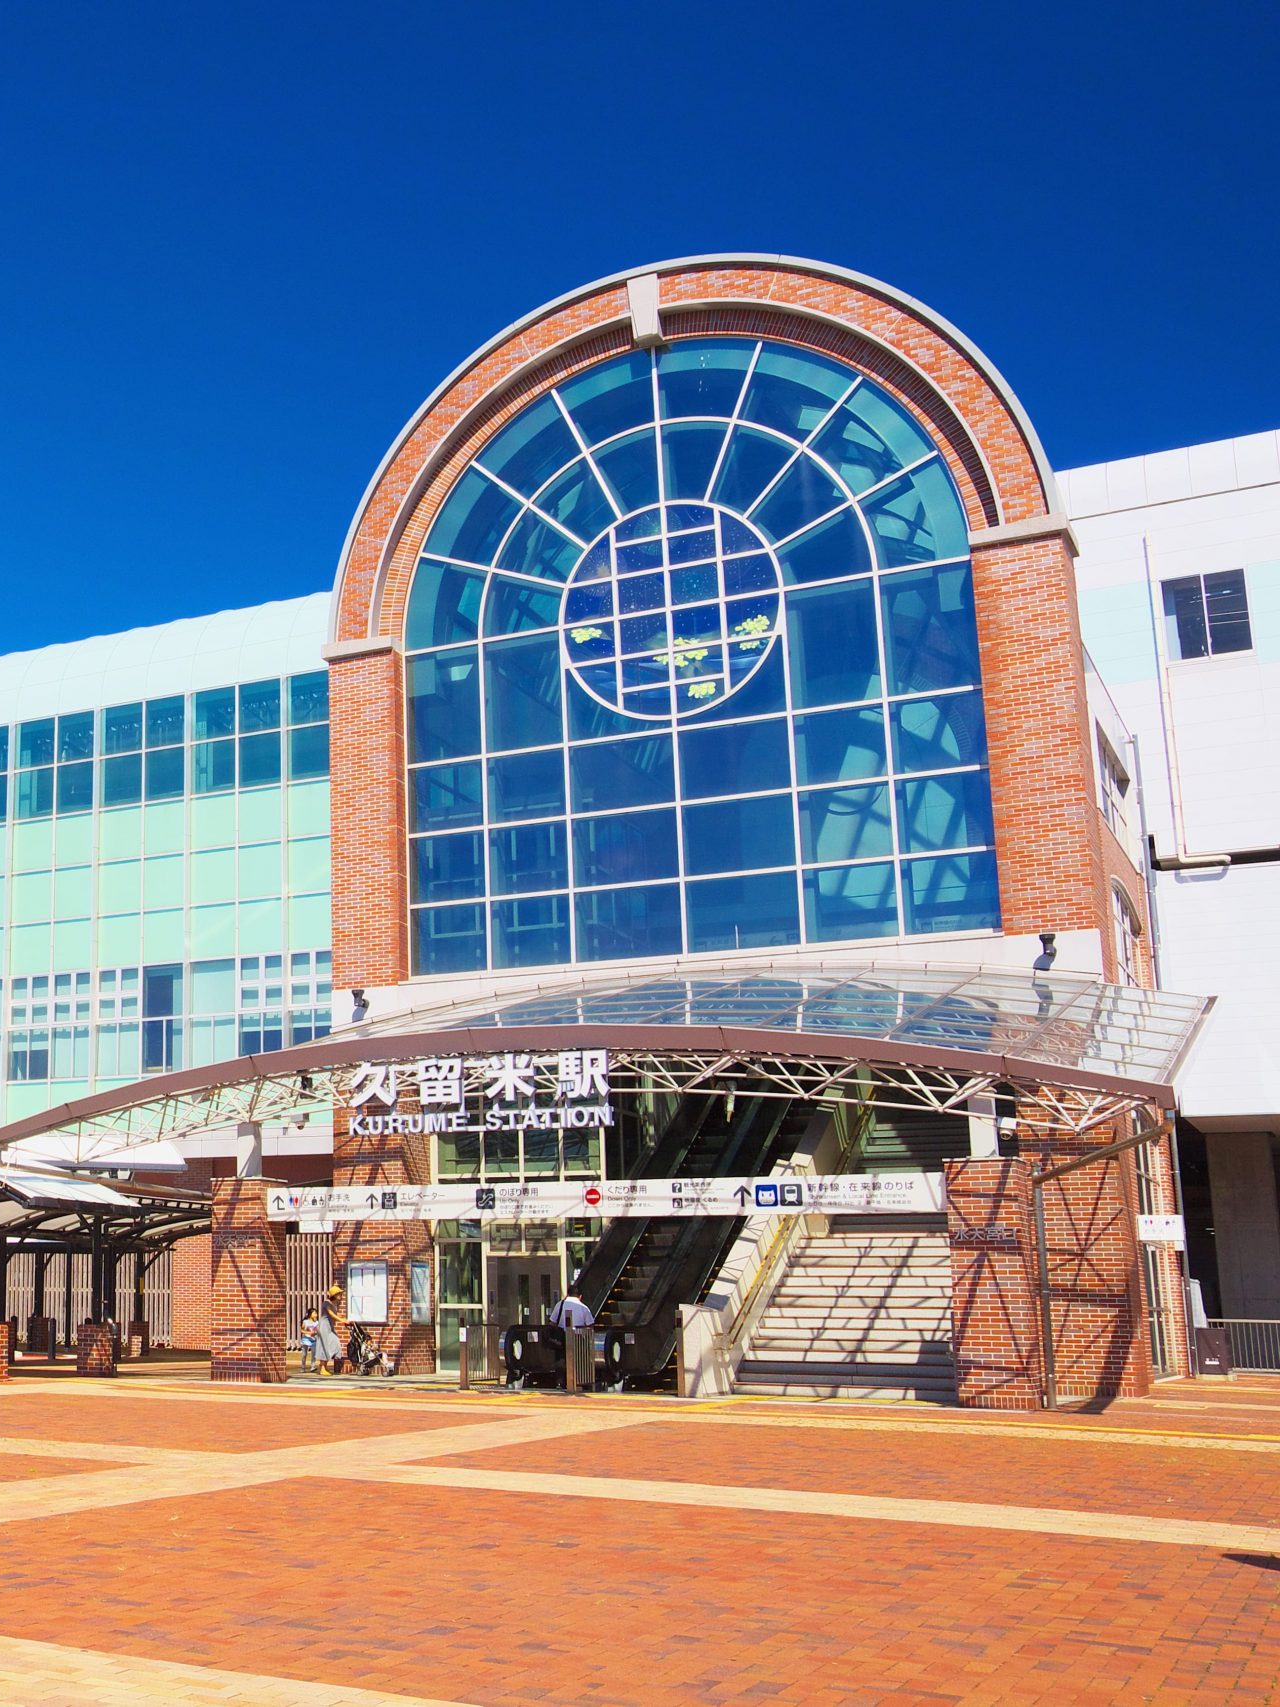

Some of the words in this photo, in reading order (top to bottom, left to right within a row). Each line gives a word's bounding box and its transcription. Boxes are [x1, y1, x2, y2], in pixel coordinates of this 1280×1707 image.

[349, 1049, 611, 1106] 久留米駅
[349, 1113, 468, 1136] KURUME
[485, 1106, 614, 1131] STATION
[500, 1187, 538, 1197] のぼり専用
[607, 1185, 647, 1194] くだり専用
[807, 1182, 914, 1193] 新幹線・在来線のりば
[401, 1192, 445, 1200] エレベーター
[954, 1227, 1016, 1240] 水天宮口
